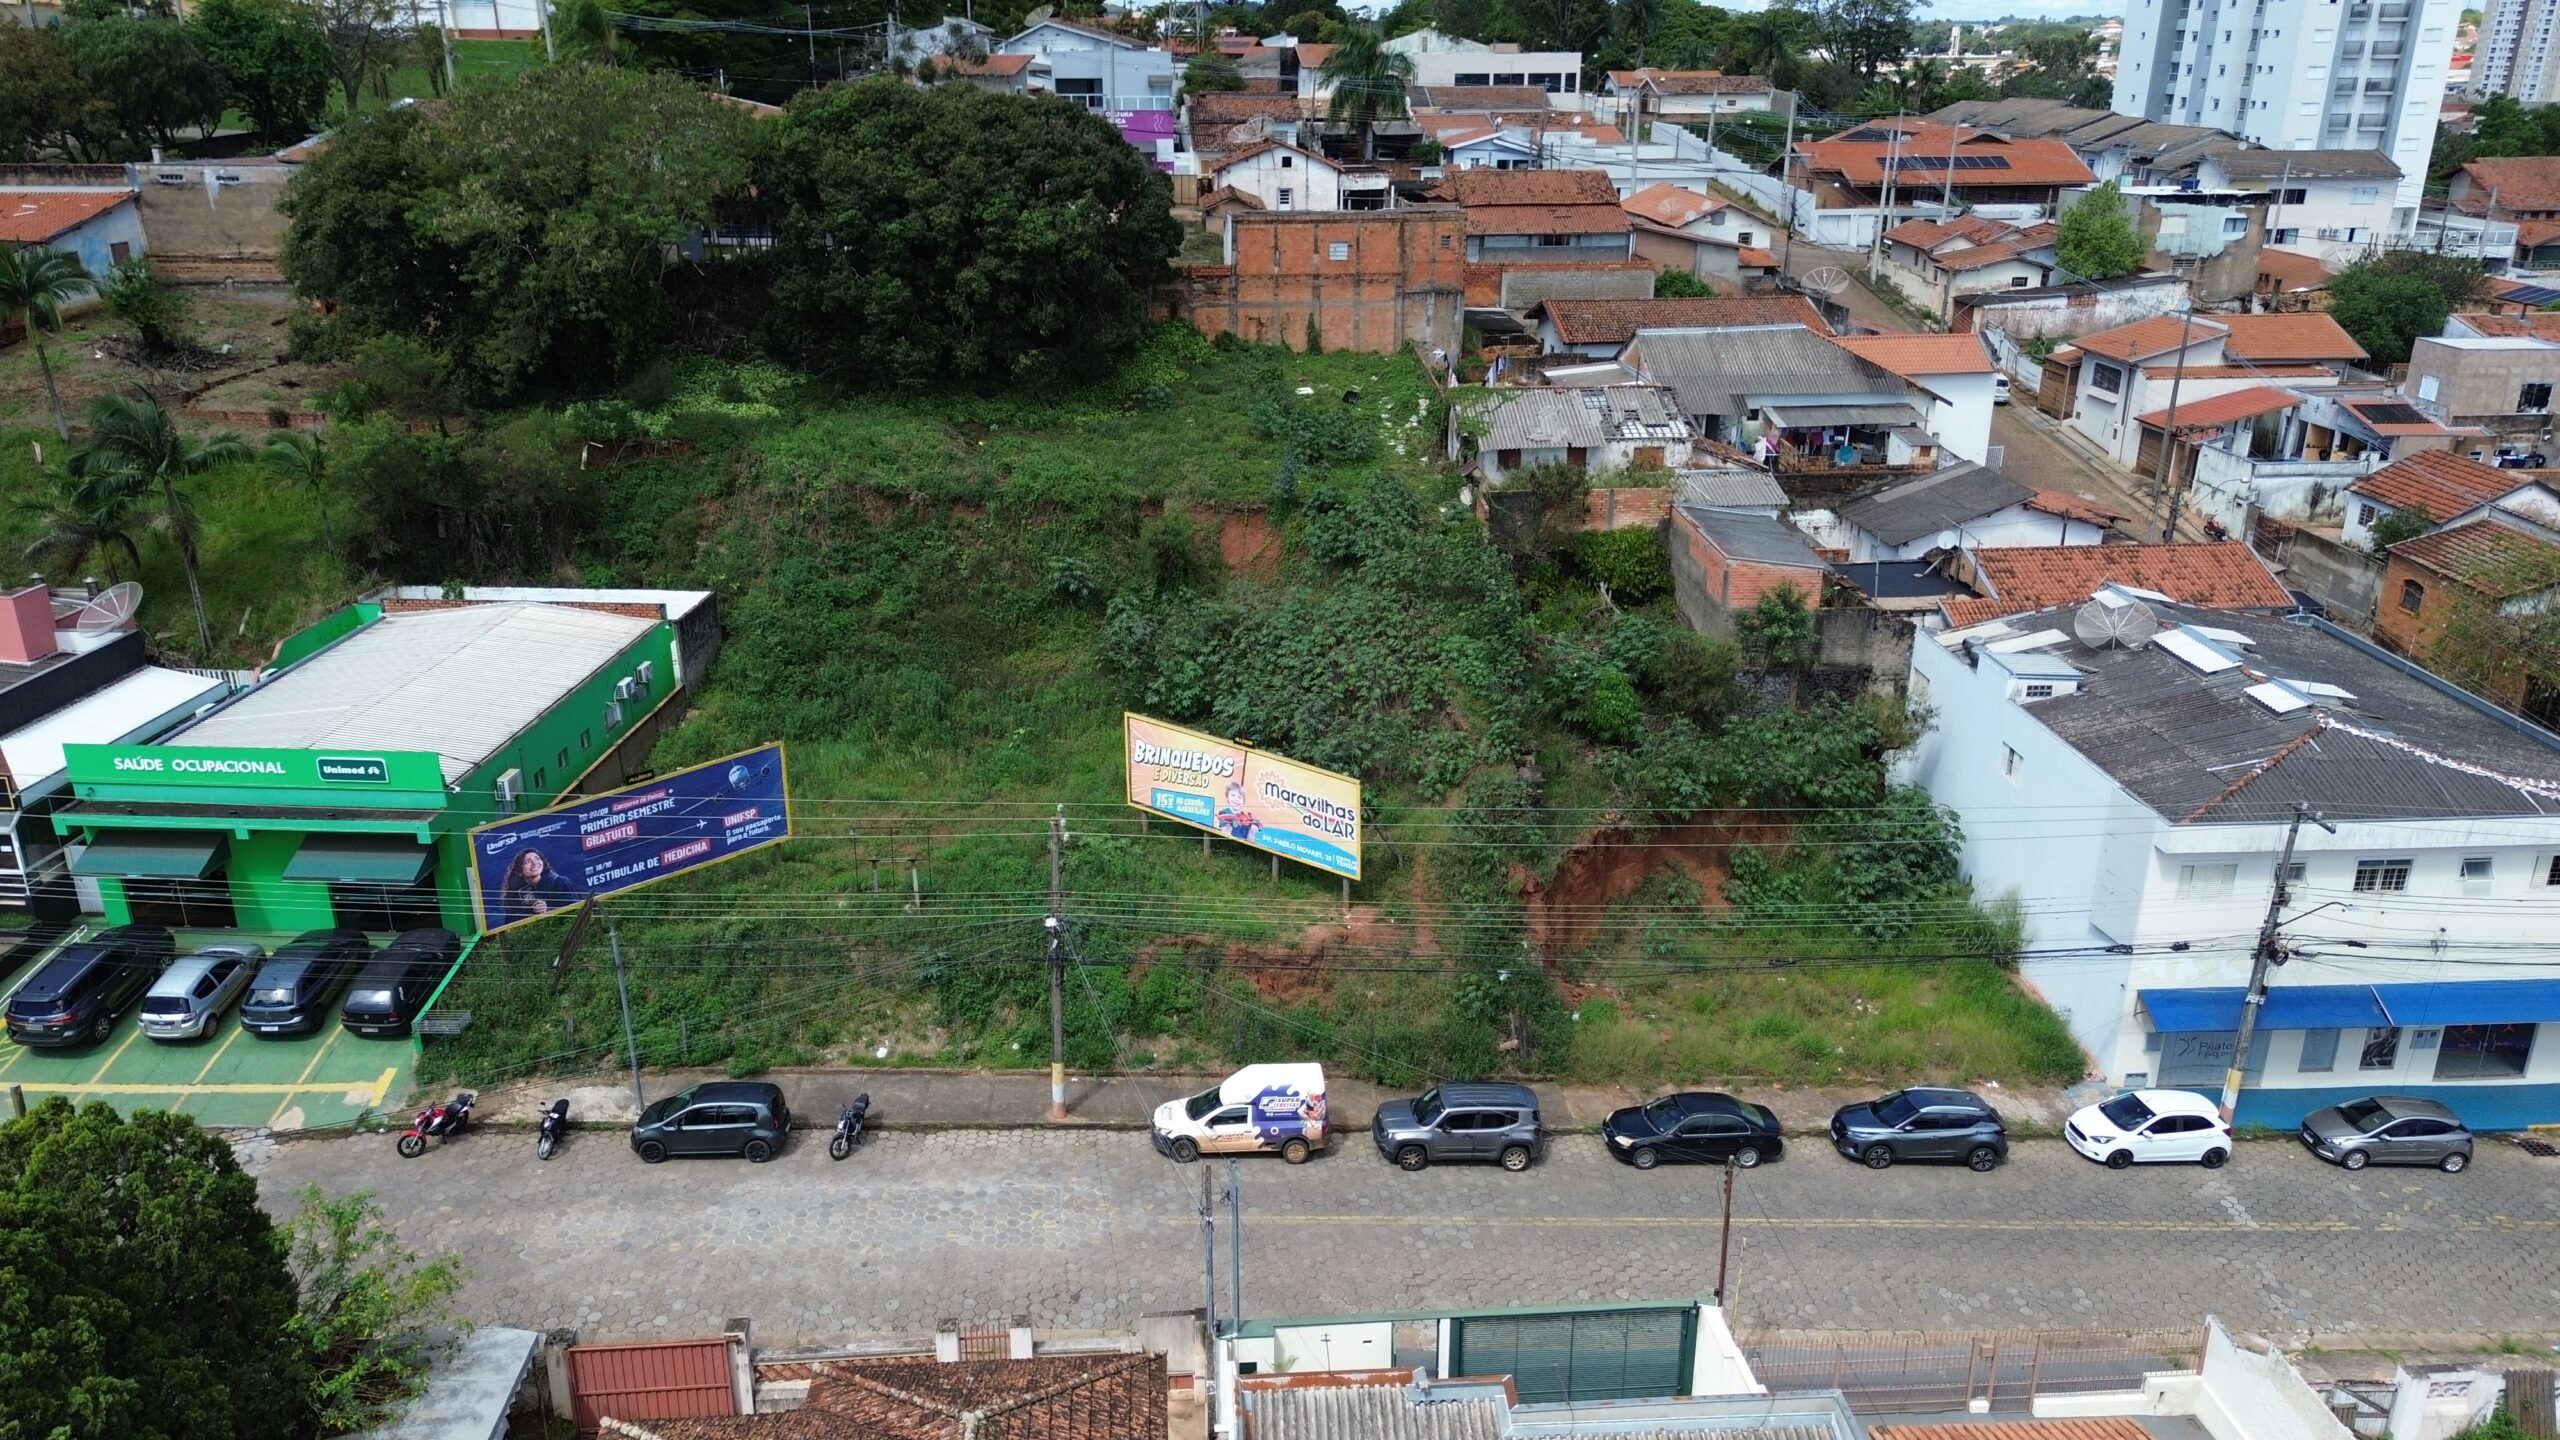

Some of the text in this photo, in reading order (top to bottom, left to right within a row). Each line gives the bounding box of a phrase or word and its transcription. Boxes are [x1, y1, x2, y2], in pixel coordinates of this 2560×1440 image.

[113, 755, 286, 774] SAÚDE OCUPACIONAL
[1134, 738, 1235, 777] BRINQUEDOS
[322, 765, 366, 775] Unimed
[1153, 767, 1209, 788] E DIVERSÃO
[580, 813, 626, 835] PRIMEIRO
[627, 799, 675, 820] SEMESTRE
[724, 808, 756, 827] UNIFSP
[745, 814, 781, 832] passaporte
[585, 825, 634, 848] GRATUITO
[1302, 814, 1355, 841] do LAR
[727, 834, 743, 845] para
[586, 841, 708, 887] VESTIBULAR DE MEDICINA
[2200, 1041, 2234, 1051] Pilate
